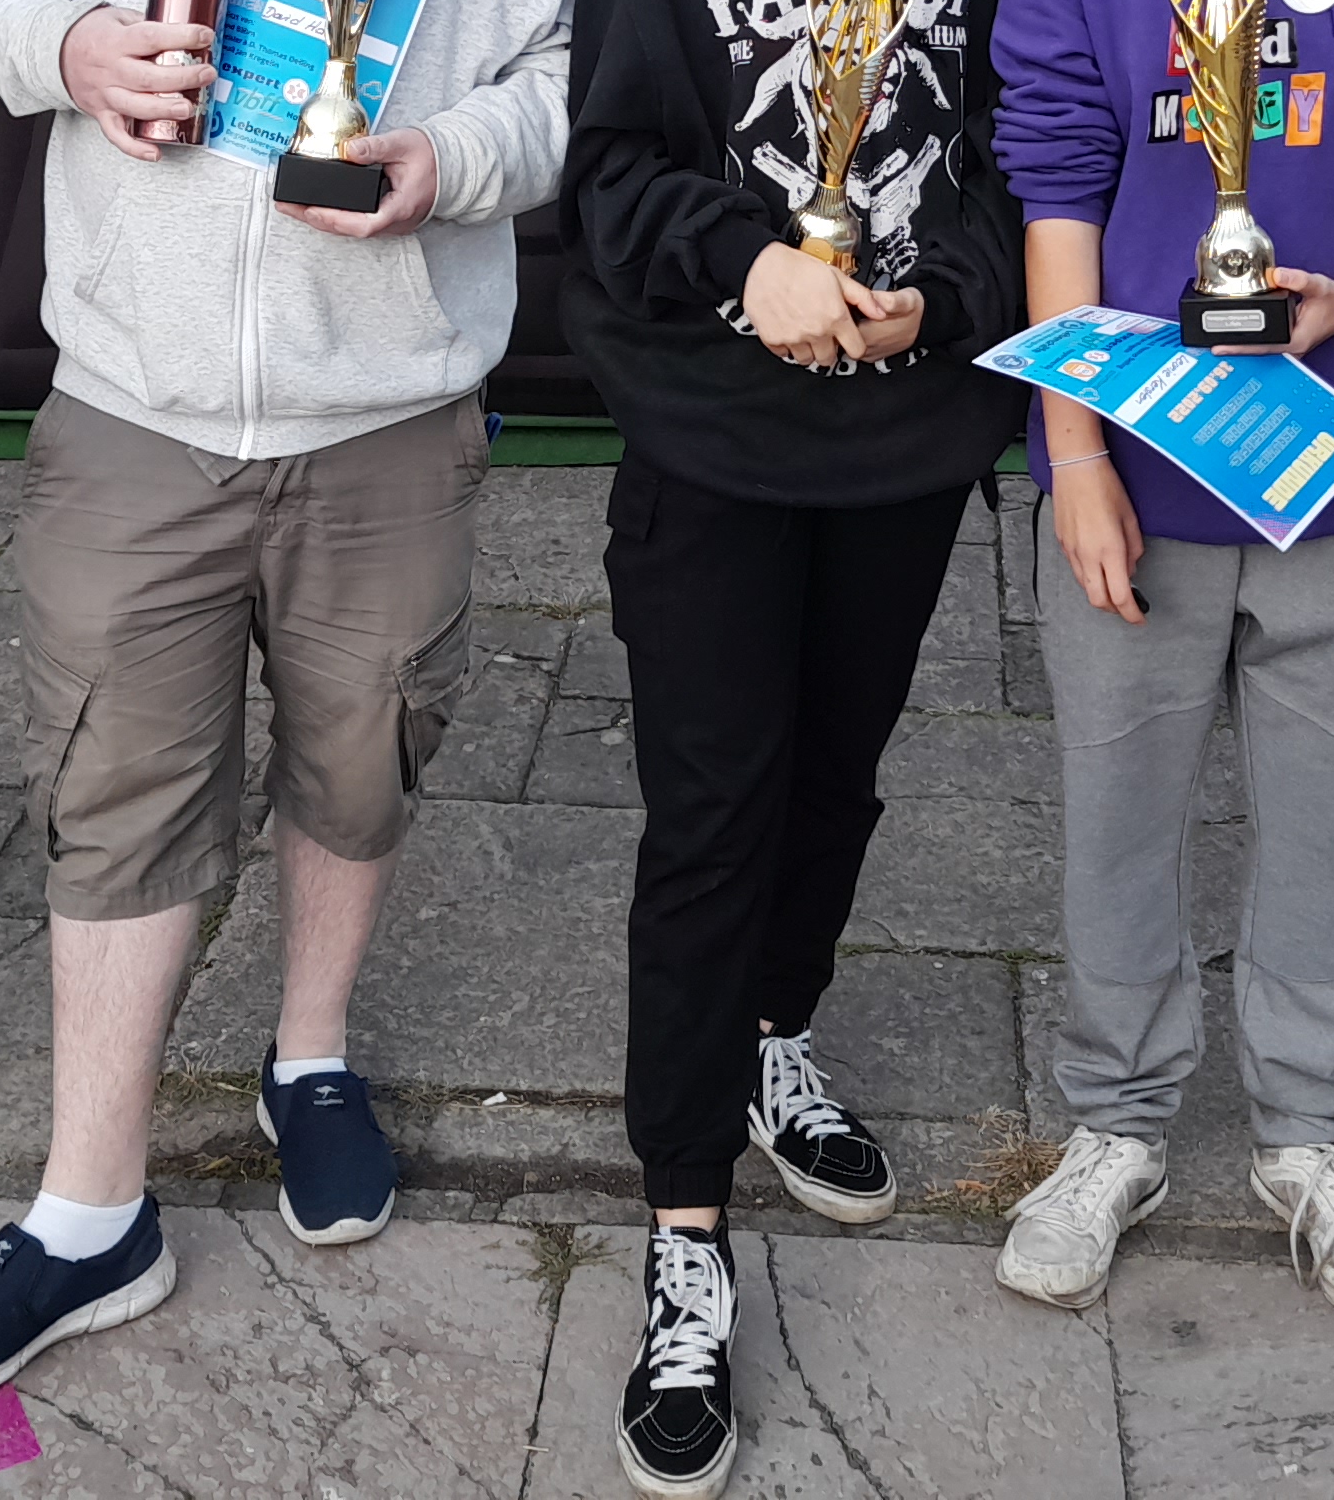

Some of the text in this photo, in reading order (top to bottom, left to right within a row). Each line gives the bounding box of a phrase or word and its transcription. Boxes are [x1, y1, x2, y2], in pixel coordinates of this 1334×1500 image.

[263, 6, 306, 26] David
[222, 62, 281, 89] expert
[1154, 90, 1320, 137] MOEY
[230, 116, 291, 146] Lebenshi
[1167, 360, 1235, 424] 16.09.2022
